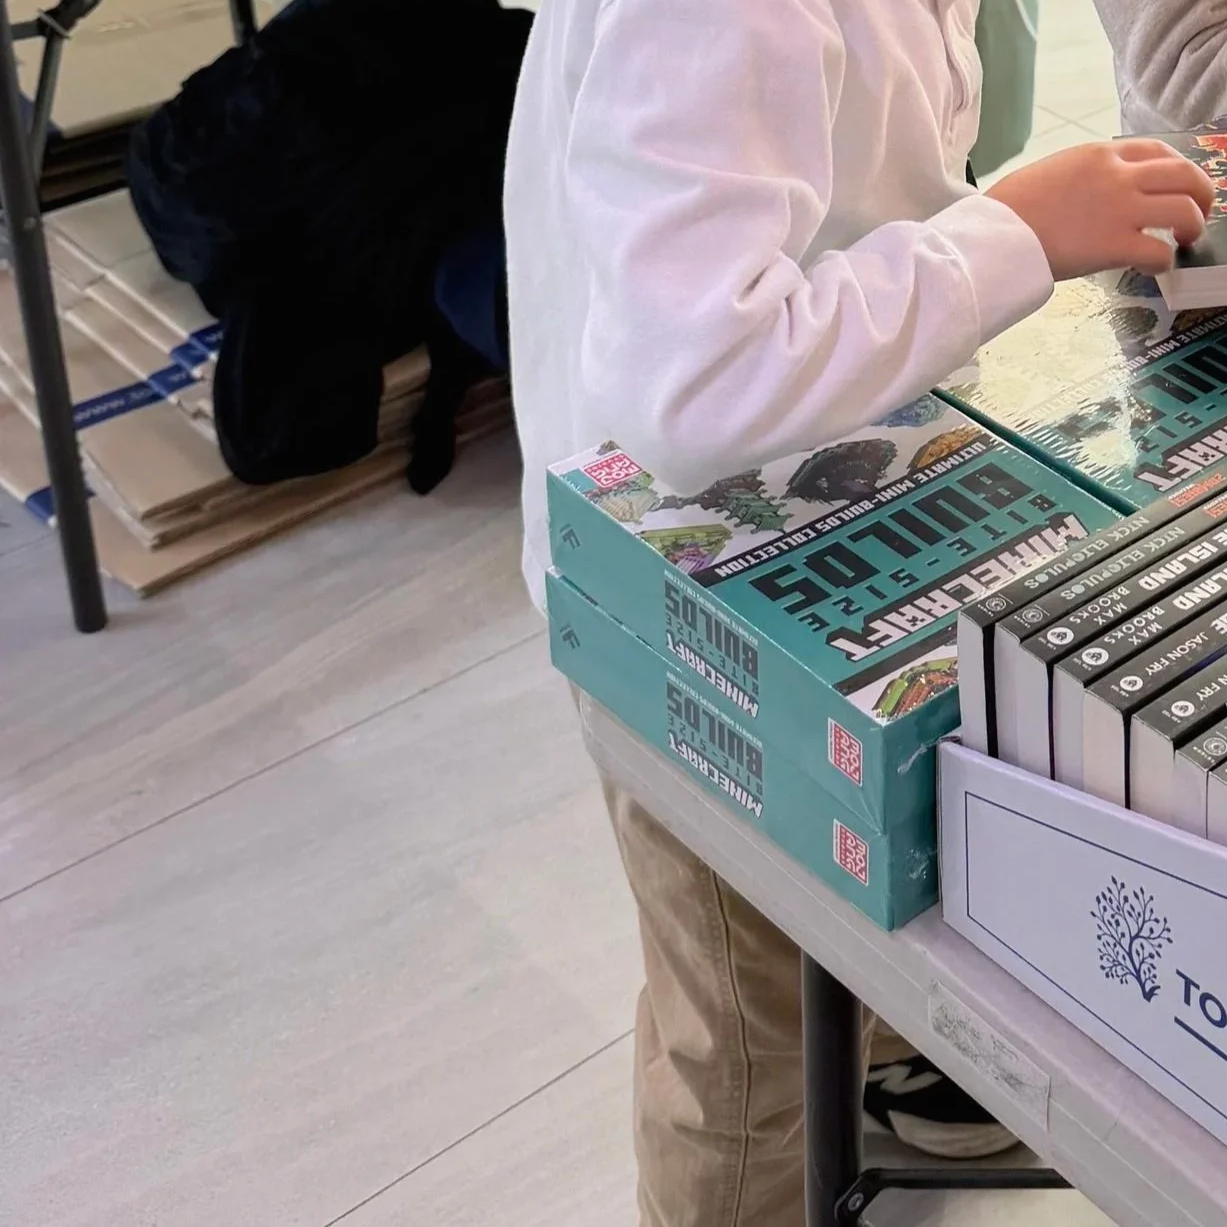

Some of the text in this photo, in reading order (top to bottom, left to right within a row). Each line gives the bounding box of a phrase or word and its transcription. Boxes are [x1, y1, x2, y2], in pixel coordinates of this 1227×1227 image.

[712, 440, 987, 583] ULTIMATE MINI-BUILDS COLLECTION
[750, 464, 1033, 615] BUILDS
[1106, 512, 1149, 543] NICK
[1142, 522, 1184, 554] NICK
[797, 496, 1058, 633] BITE-SIZE
[829, 513, 1091, 662] MINECRAFT
[1022, 535, 1109, 591] ELIOPULOS
[1058, 546, 1143, 603] ELIOPULOS
[1136, 537, 1216, 593] ISLAND
[663, 577, 758, 679] BUILDS
[1067, 583, 1130, 628] BROOKS
[1091, 599, 1127, 627] MAX
[1101, 602, 1165, 647] BROOKS
[1126, 619, 1162, 647] MAX
[662, 627, 757, 717] MINECRAFT
[1143, 654, 1170, 678] FRY
[1167, 629, 1209, 661] JASON
[1194, 679, 1220, 702] FRY
[667, 677, 761, 779] BUILDS
[666, 727, 761, 817] MINECRAFT
